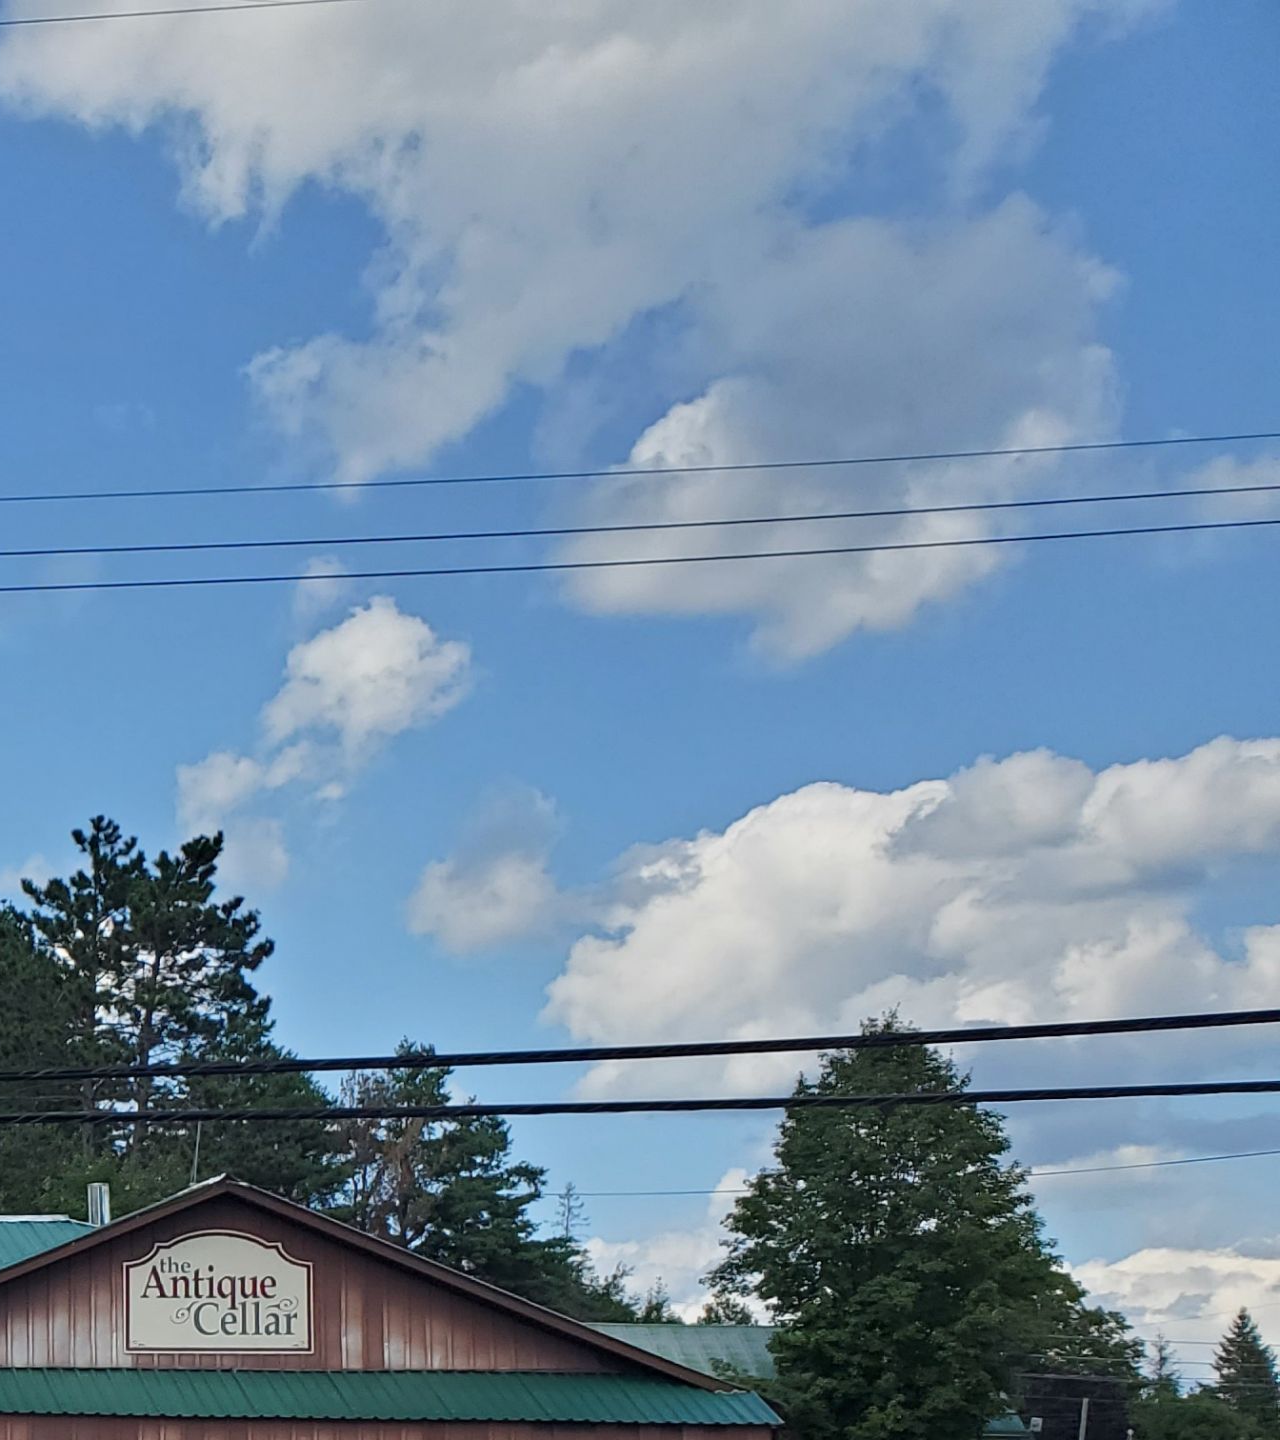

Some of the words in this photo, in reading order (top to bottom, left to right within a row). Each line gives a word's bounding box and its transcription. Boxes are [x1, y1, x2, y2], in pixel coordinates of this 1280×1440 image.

[160, 1256, 191, 1273] the
[140, 1264, 277, 1309] Antique
[193, 1301, 298, 1336] Cellar
